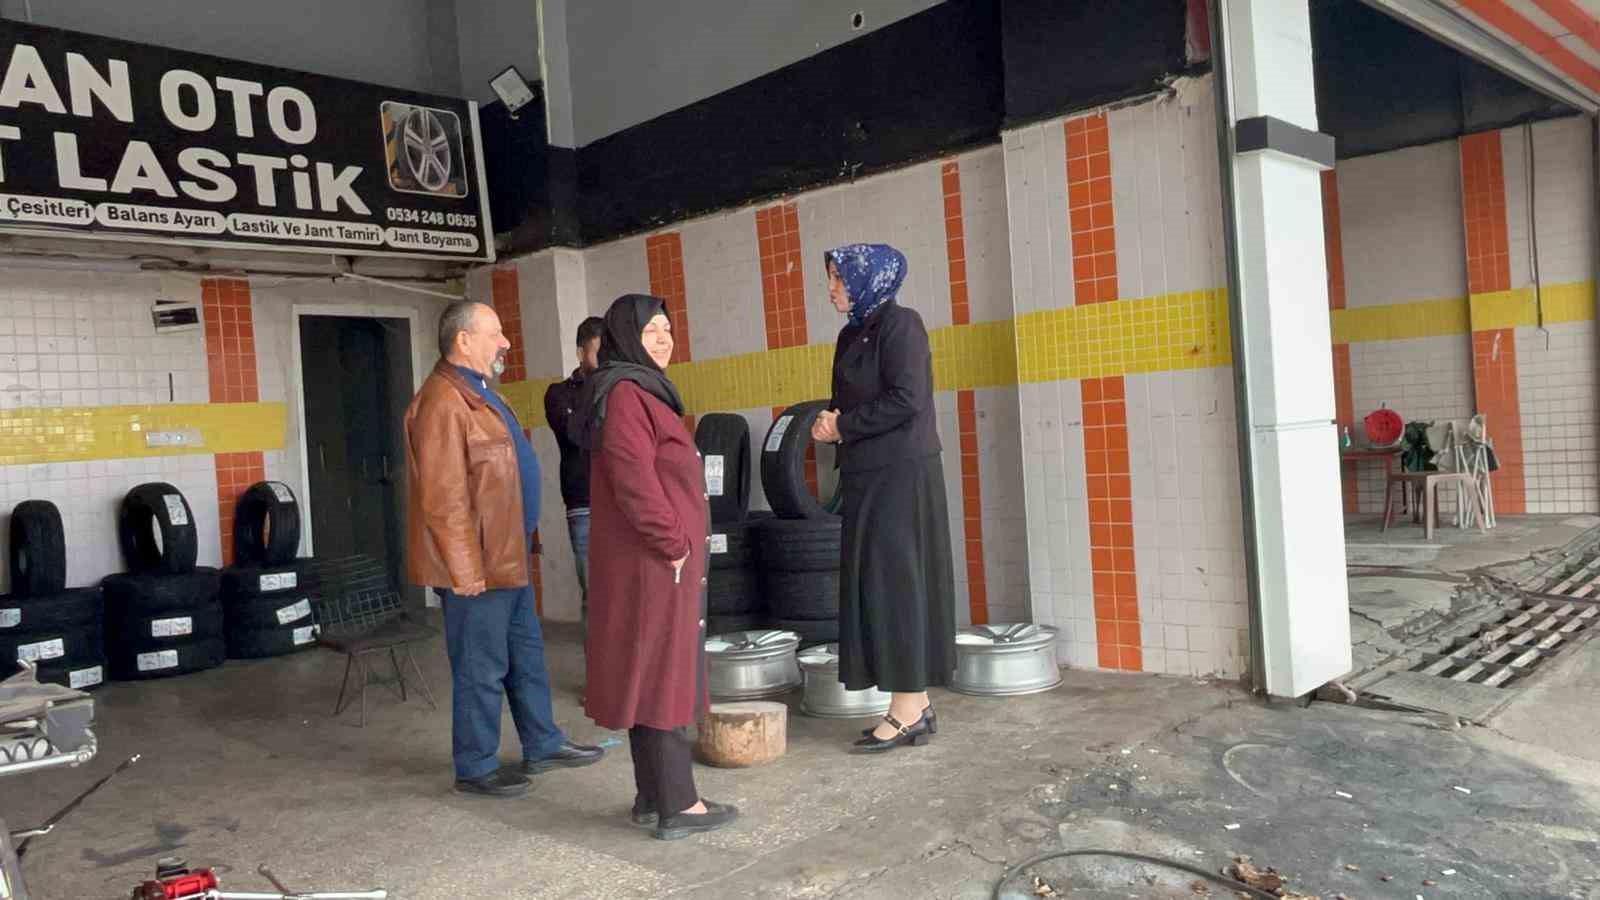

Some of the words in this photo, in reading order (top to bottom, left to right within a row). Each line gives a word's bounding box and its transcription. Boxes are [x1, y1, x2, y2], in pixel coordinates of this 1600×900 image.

[160, 69, 317, 145] OTO
[107, 206, 169, 224] Balans
[173, 211, 215, 229] Ayarı
[386, 207, 419, 223] 0534
[421, 210, 444, 225] 248
[233, 218, 279, 235] Lastik
[283, 222, 301, 236] Ve
[304, 223, 335, 238] Jant
[336, 226, 380, 241] Tamiri
[393, 229, 420, 244] Jant
[422, 232, 472, 248] Boyama
